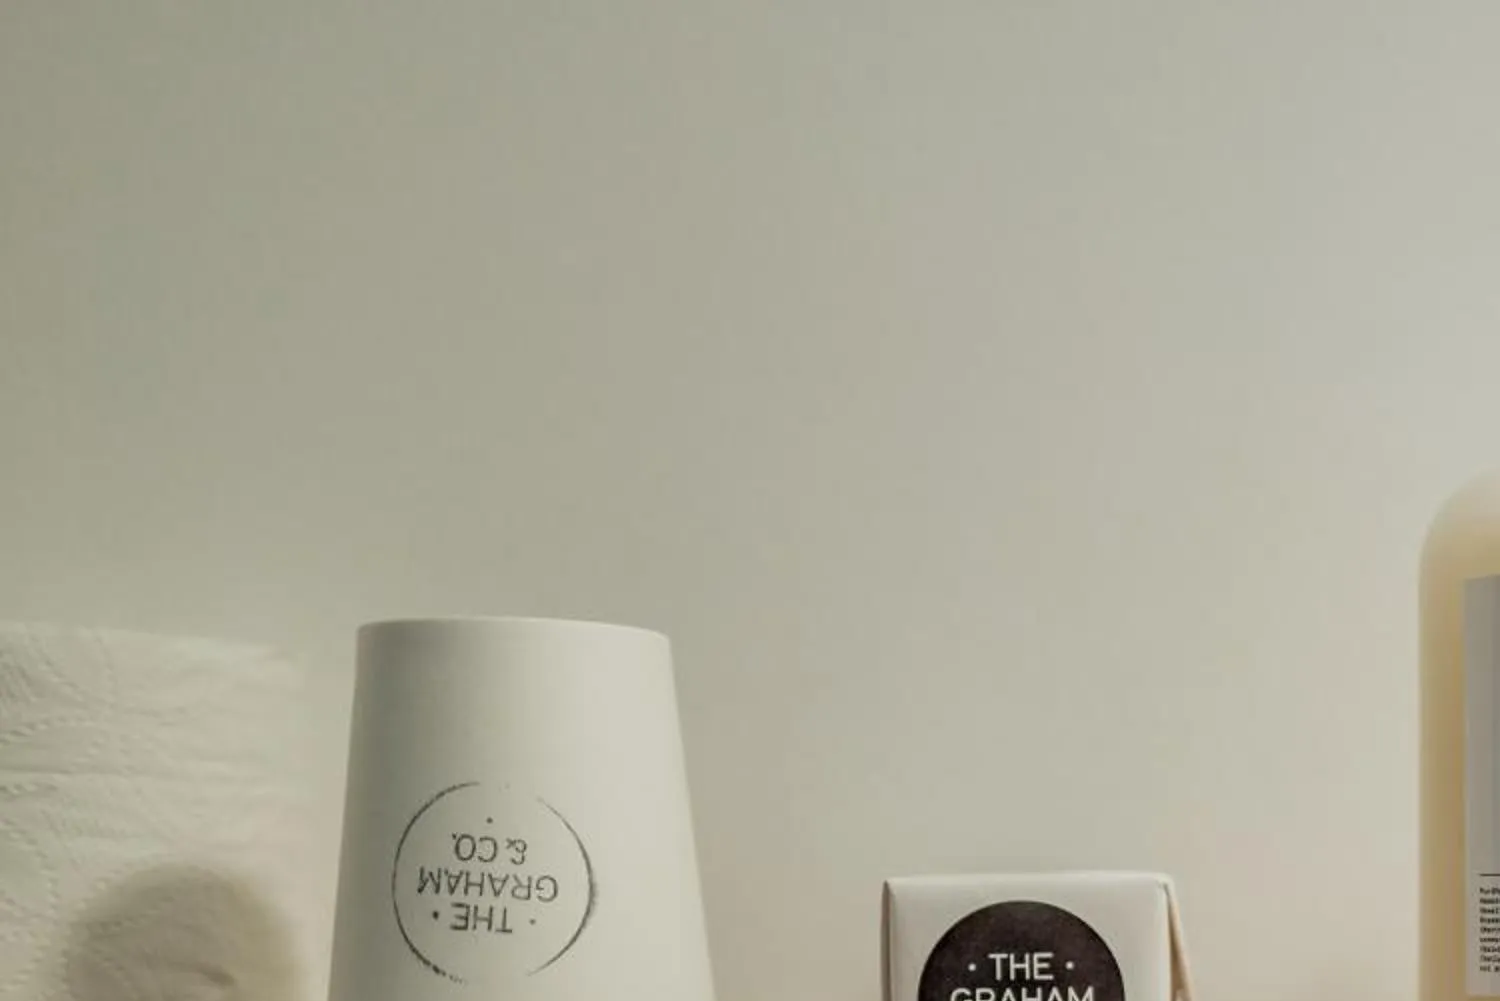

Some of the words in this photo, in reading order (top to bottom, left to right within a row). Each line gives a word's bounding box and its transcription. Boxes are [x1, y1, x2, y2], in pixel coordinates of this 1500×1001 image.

[452, 831, 499, 863] CO.
[506, 838, 527, 865] &
[416, 866, 559, 903] GRAHAM
[449, 902, 513, 933] THE
[987, 952, 1054, 981] THE
